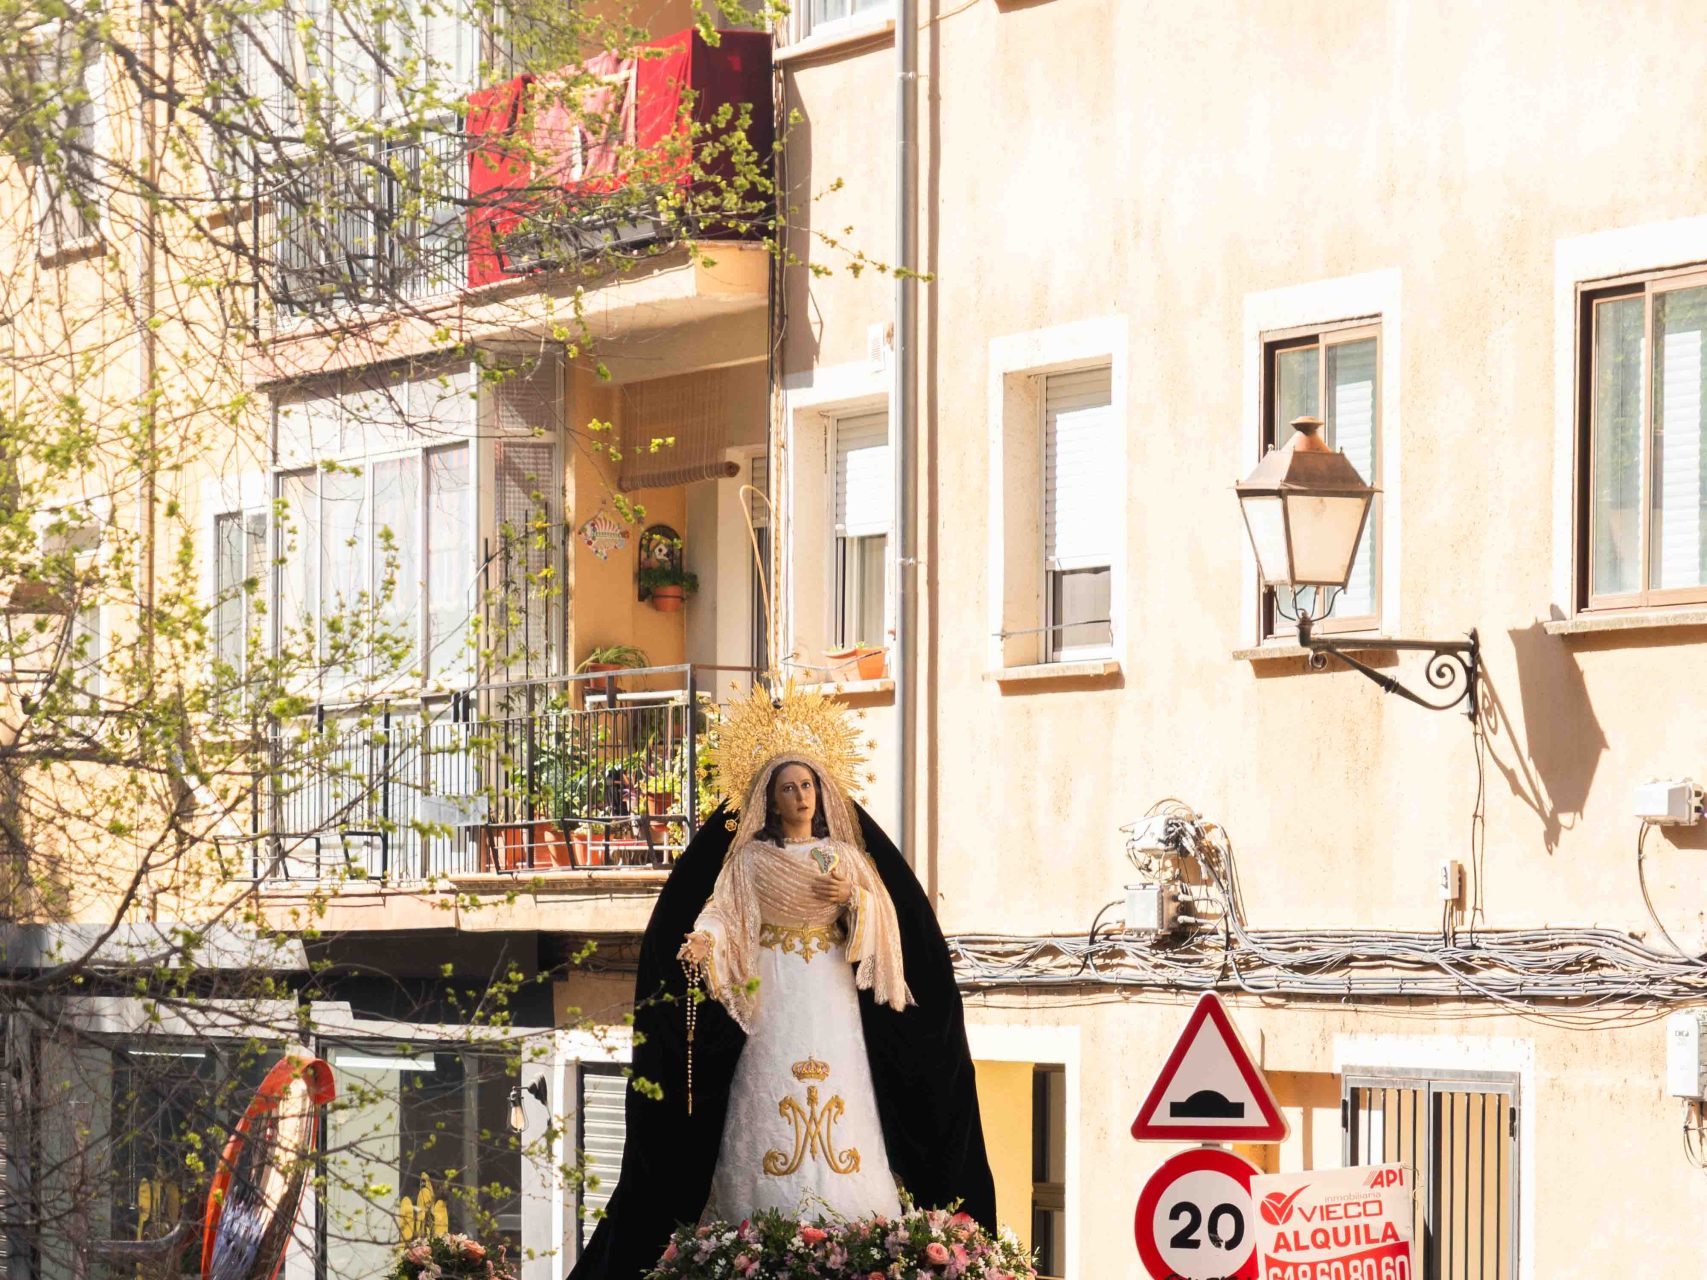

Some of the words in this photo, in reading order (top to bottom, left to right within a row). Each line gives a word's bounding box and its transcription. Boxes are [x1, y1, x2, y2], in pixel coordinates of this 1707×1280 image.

[1370, 1168, 1404, 1189] API
[1324, 1191, 1382, 1203] inmobiliaria
[1298, 1200, 1383, 1222] VIECO
[1168, 1201, 1245, 1250] 20
[1273, 1221, 1401, 1254] ALQUILA
